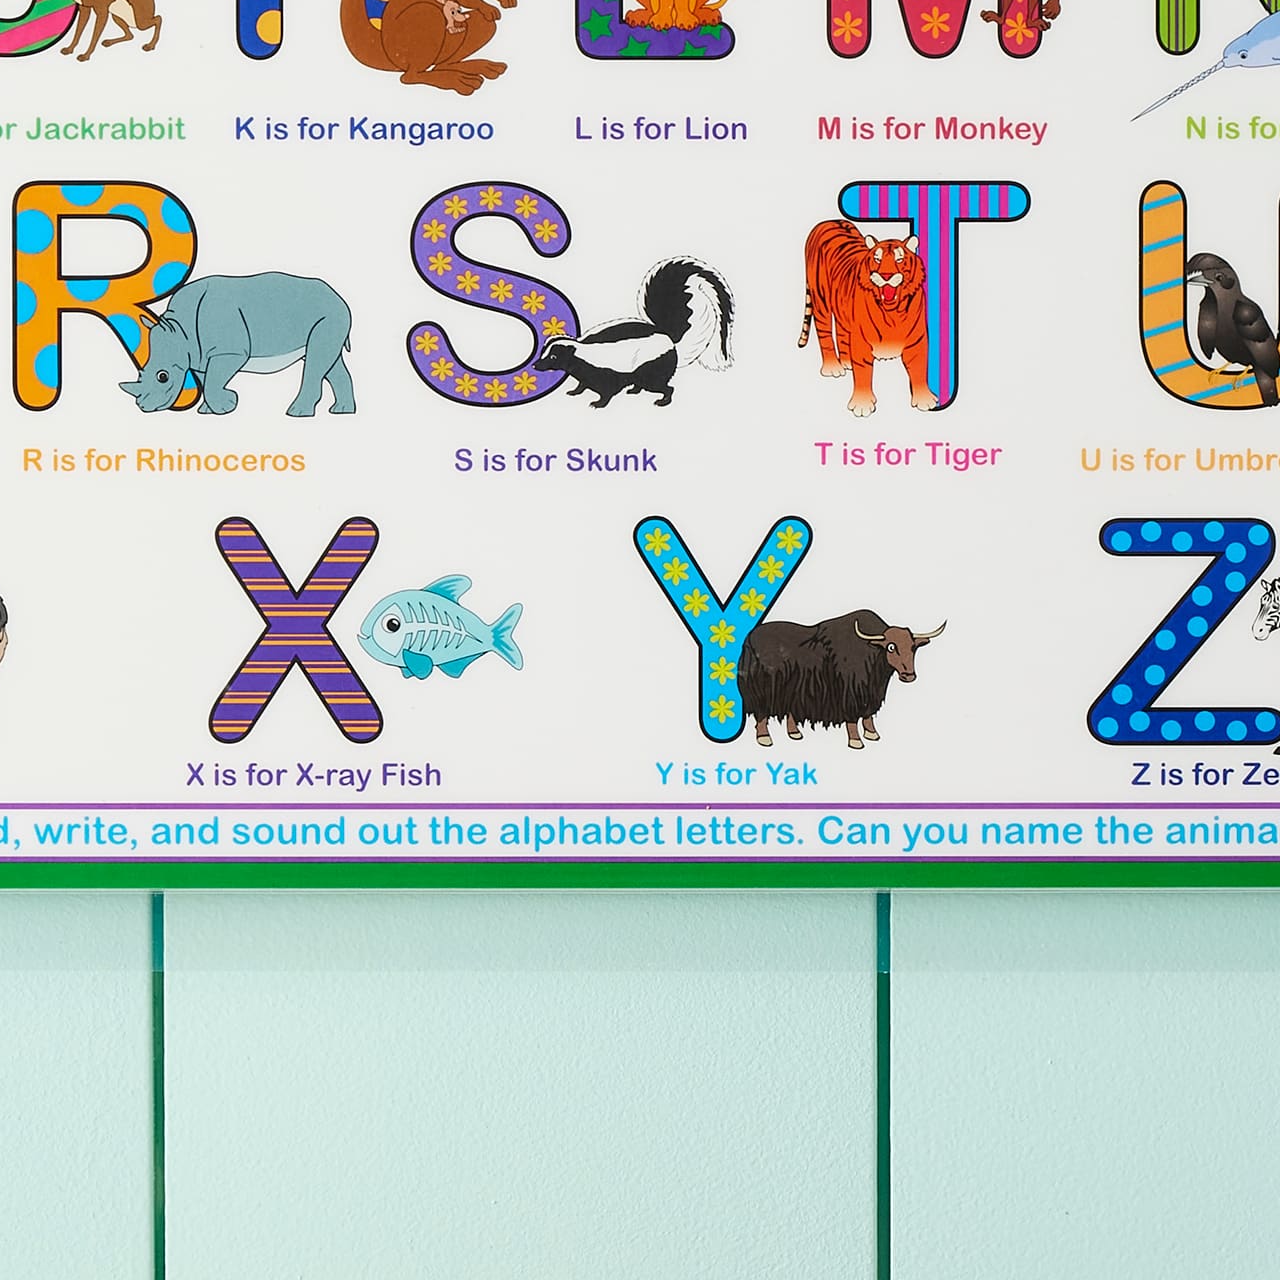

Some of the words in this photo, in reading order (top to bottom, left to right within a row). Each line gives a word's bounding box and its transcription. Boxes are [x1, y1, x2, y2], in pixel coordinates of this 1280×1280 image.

[236, 117, 255, 140] K
[266, 117, 288, 140] is
[297, 117, 340, 140] for
[350, 117, 494, 146] Kangaroo
[1186, 116, 1206, 139] N
[1218, 116, 1240, 139] is
[23, 448, 42, 471] R
[53, 449, 75, 471] is
[84, 448, 126, 472] for
[136, 448, 305, 472] Rhinoceros
[1081, 448, 1100, 471] U
[1112, 449, 1134, 471] is
[1144, 448, 1185, 471] for
[209, 517, 384, 744] X
[187, 763, 204, 786] X
[215, 763, 236, 786] is
[245, 763, 288, 786] for
[296, 763, 371, 792] X-ray
[382, 763, 441, 786] Fish
[1131, 763, 1151, 785] Z
[1161, 763, 1183, 786] is
[1192, 762, 1234, 785] for
[34, 816, 137, 850] write,
[151, 816, 219, 845] and
[233, 816, 345, 845] sound
[358, 817, 419, 845] out
[429, 816, 487, 845] the
[500, 816, 665, 851] alphabet
[677, 816, 803, 845] letters.
[818, 815, 890, 845] Can
[902, 823, 968, 851] you
[982, 823, 1083, 845] name
[1095, 816, 1153, 845] the
